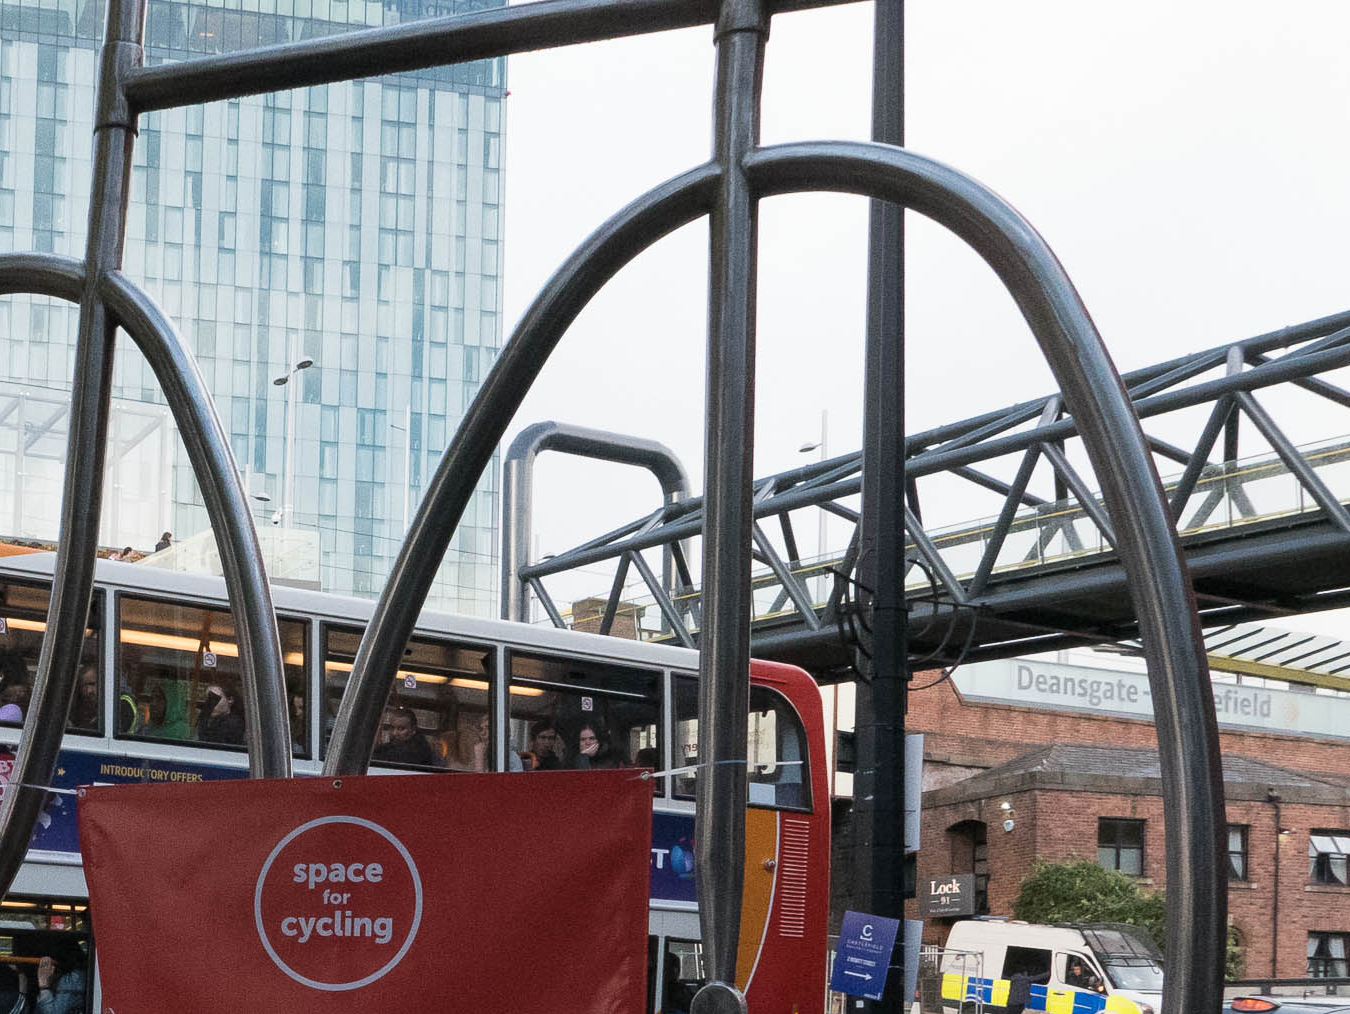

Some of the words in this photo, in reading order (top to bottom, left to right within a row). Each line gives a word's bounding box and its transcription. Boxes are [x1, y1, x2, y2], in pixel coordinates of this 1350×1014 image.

[1017, 665, 1139, 706] Deansgate
[100, 764, 169, 780] INTRODUCTORY
[170, 771, 203, 783] OFFERS
[293, 862, 384, 889] space
[930, 879, 961, 895] Lock
[322, 889, 351, 904] for
[281, 910, 393, 944] cycling
